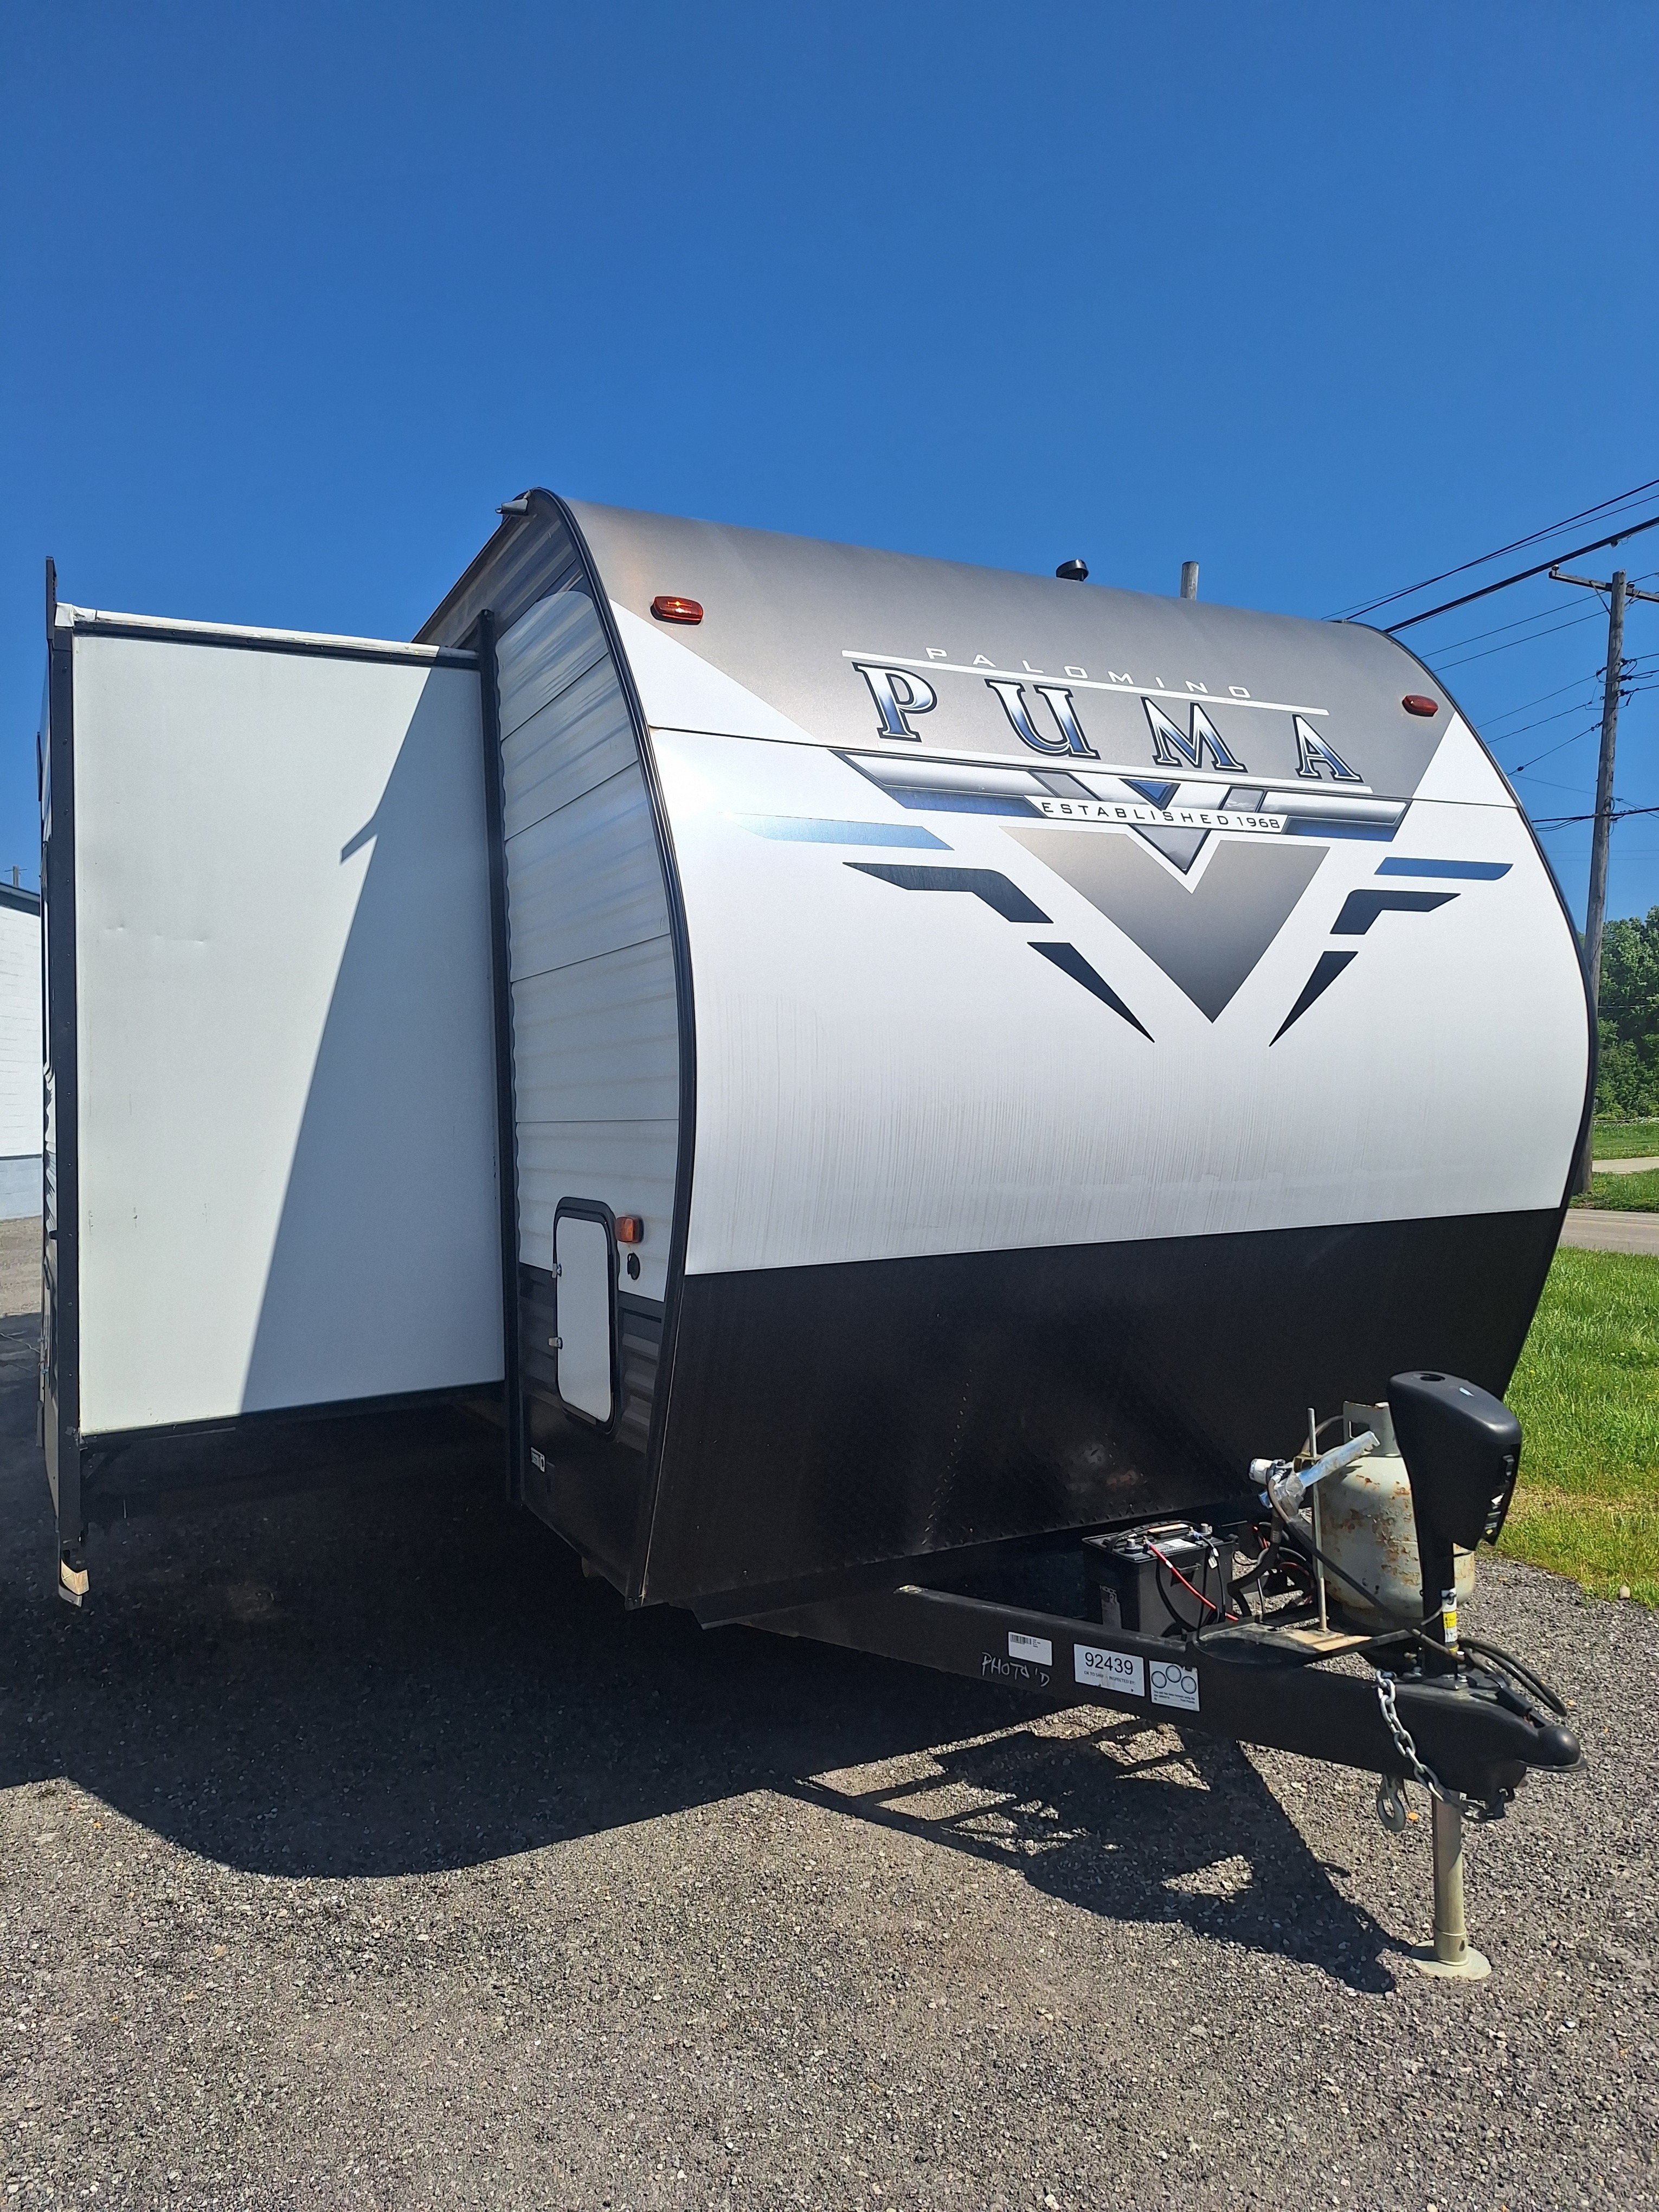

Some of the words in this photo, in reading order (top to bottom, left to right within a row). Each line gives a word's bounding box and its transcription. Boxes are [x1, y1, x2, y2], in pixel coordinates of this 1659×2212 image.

[925, 647, 1251, 698] PALOMINO
[851, 661, 1365, 783] PUMA
[1041, 802, 1229, 825] ESTABLISHED
[1236, 816, 1281, 829] 1968
[1085, 1652, 1133, 1675] 92439
